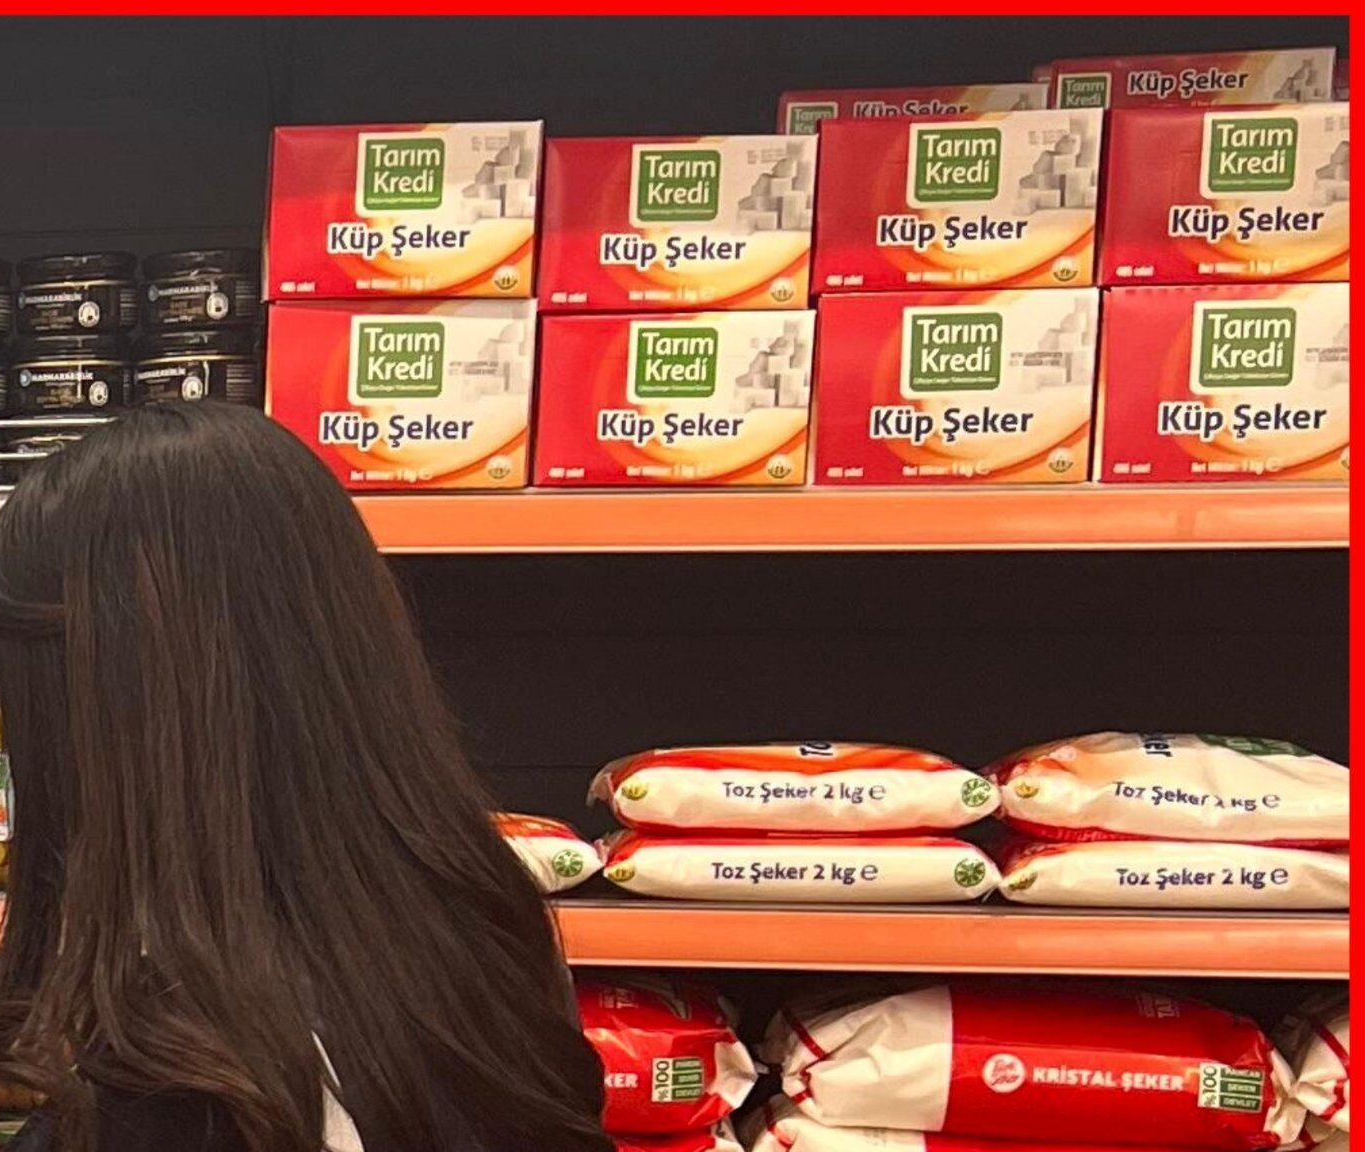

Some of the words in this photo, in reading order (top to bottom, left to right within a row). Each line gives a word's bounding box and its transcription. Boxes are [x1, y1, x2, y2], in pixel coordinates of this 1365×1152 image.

[1128, 71, 1174, 97] Küp
[1179, 69, 1248, 95] Şeker
[922, 134, 997, 158] Tarım
[1216, 124, 1294, 148] Tarım
[371, 145, 441, 169] Tarım
[645, 155, 716, 179] Tarım
[1220, 151, 1285, 175] Kredi
[373, 171, 434, 193] Kredi
[925, 161, 990, 184] Kredi
[648, 181, 709, 205] Kredi
[880, 218, 935, 248] Küp
[944, 216, 1028, 248] Şeker
[1172, 209, 1229, 239] Küp
[1238, 207, 1324, 238] Şeker
[331, 226, 383, 256] Küp
[392, 225, 470, 256] Şeker
[604, 238, 656, 266] Küp
[667, 237, 746, 267] Şeker
[364, 327, 441, 354] Tarım
[917, 319, 998, 345] Tarım
[1208, 315, 1291, 340] Tarım
[642, 332, 714, 356] Tarım
[1210, 342, 1283, 368] Kredi
[368, 355, 433, 381] Kredi
[645, 357, 707, 382] Kredi
[920, 347, 991, 373] Kredi
[323, 416, 380, 448] Küp
[388, 414, 474, 448] Şeker
[601, 414, 654, 444] Küp
[664, 413, 743, 444] Şeker
[873, 409, 933, 441] Küp
[943, 408, 1033, 442] Şeker
[1162, 405, 1224, 436] Küp
[1233, 403, 1327, 438] Şeker
[722, 782, 754, 797] Toz
[760, 782, 817, 803] Şeker
[823, 784, 834, 797] 2
[840, 782, 864, 803] kg
[1113, 781, 1144, 798] Toz
[1151, 786, 1209, 807] Şeker
[712, 862, 745, 880] Toz
[750, 862, 808, 884] Şeker
[813, 864, 825, 879] 2
[831, 863, 856, 885] kg
[1117, 868, 1150, 886] Toz
[1156, 868, 1215, 890] Şeker
[1222, 870, 1233, 885] 2
[1240, 867, 1266, 889] kg
[1032, 1064, 1117, 1088] KRİSTAL
[1120, 1071, 1185, 1092] ŞEKER
